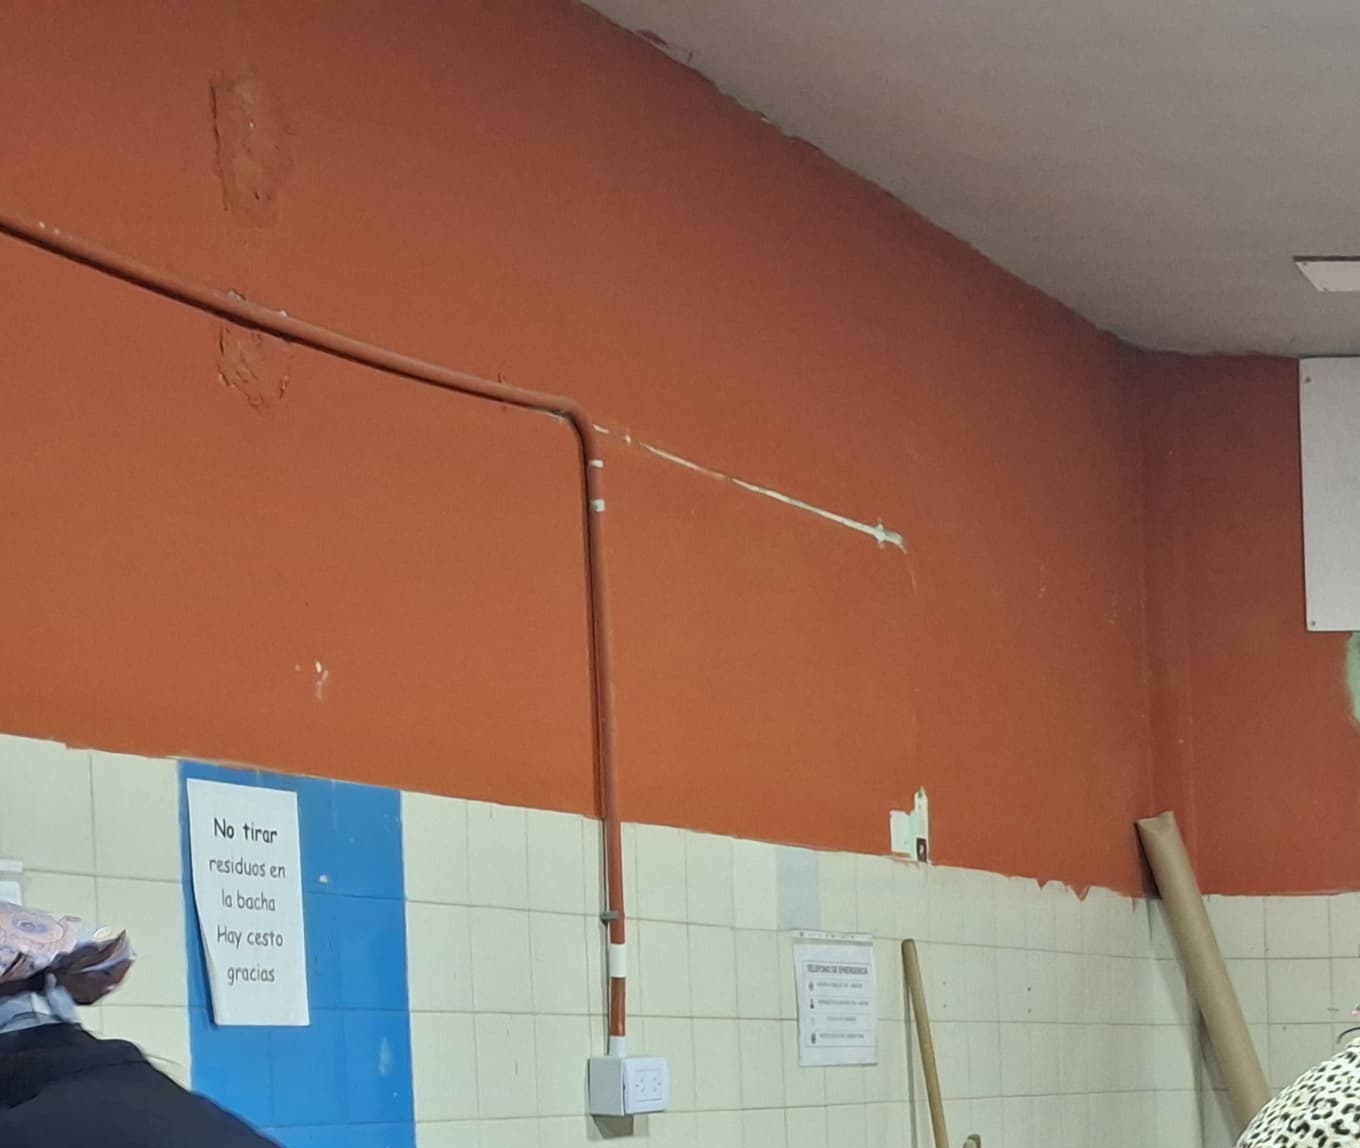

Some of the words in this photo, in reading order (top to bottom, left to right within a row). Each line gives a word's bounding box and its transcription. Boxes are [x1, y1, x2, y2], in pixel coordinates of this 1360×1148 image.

[213, 818, 235, 840] No
[243, 822, 278, 844] tirar
[209, 857, 266, 879] residuos
[270, 864, 286, 879] en
[221, 888, 233, 908] la
[237, 889, 276, 912] bacha
[217, 924, 242, 950] Hay
[247, 929, 284, 947] cesto
[227, 963, 275, 986] gracias
